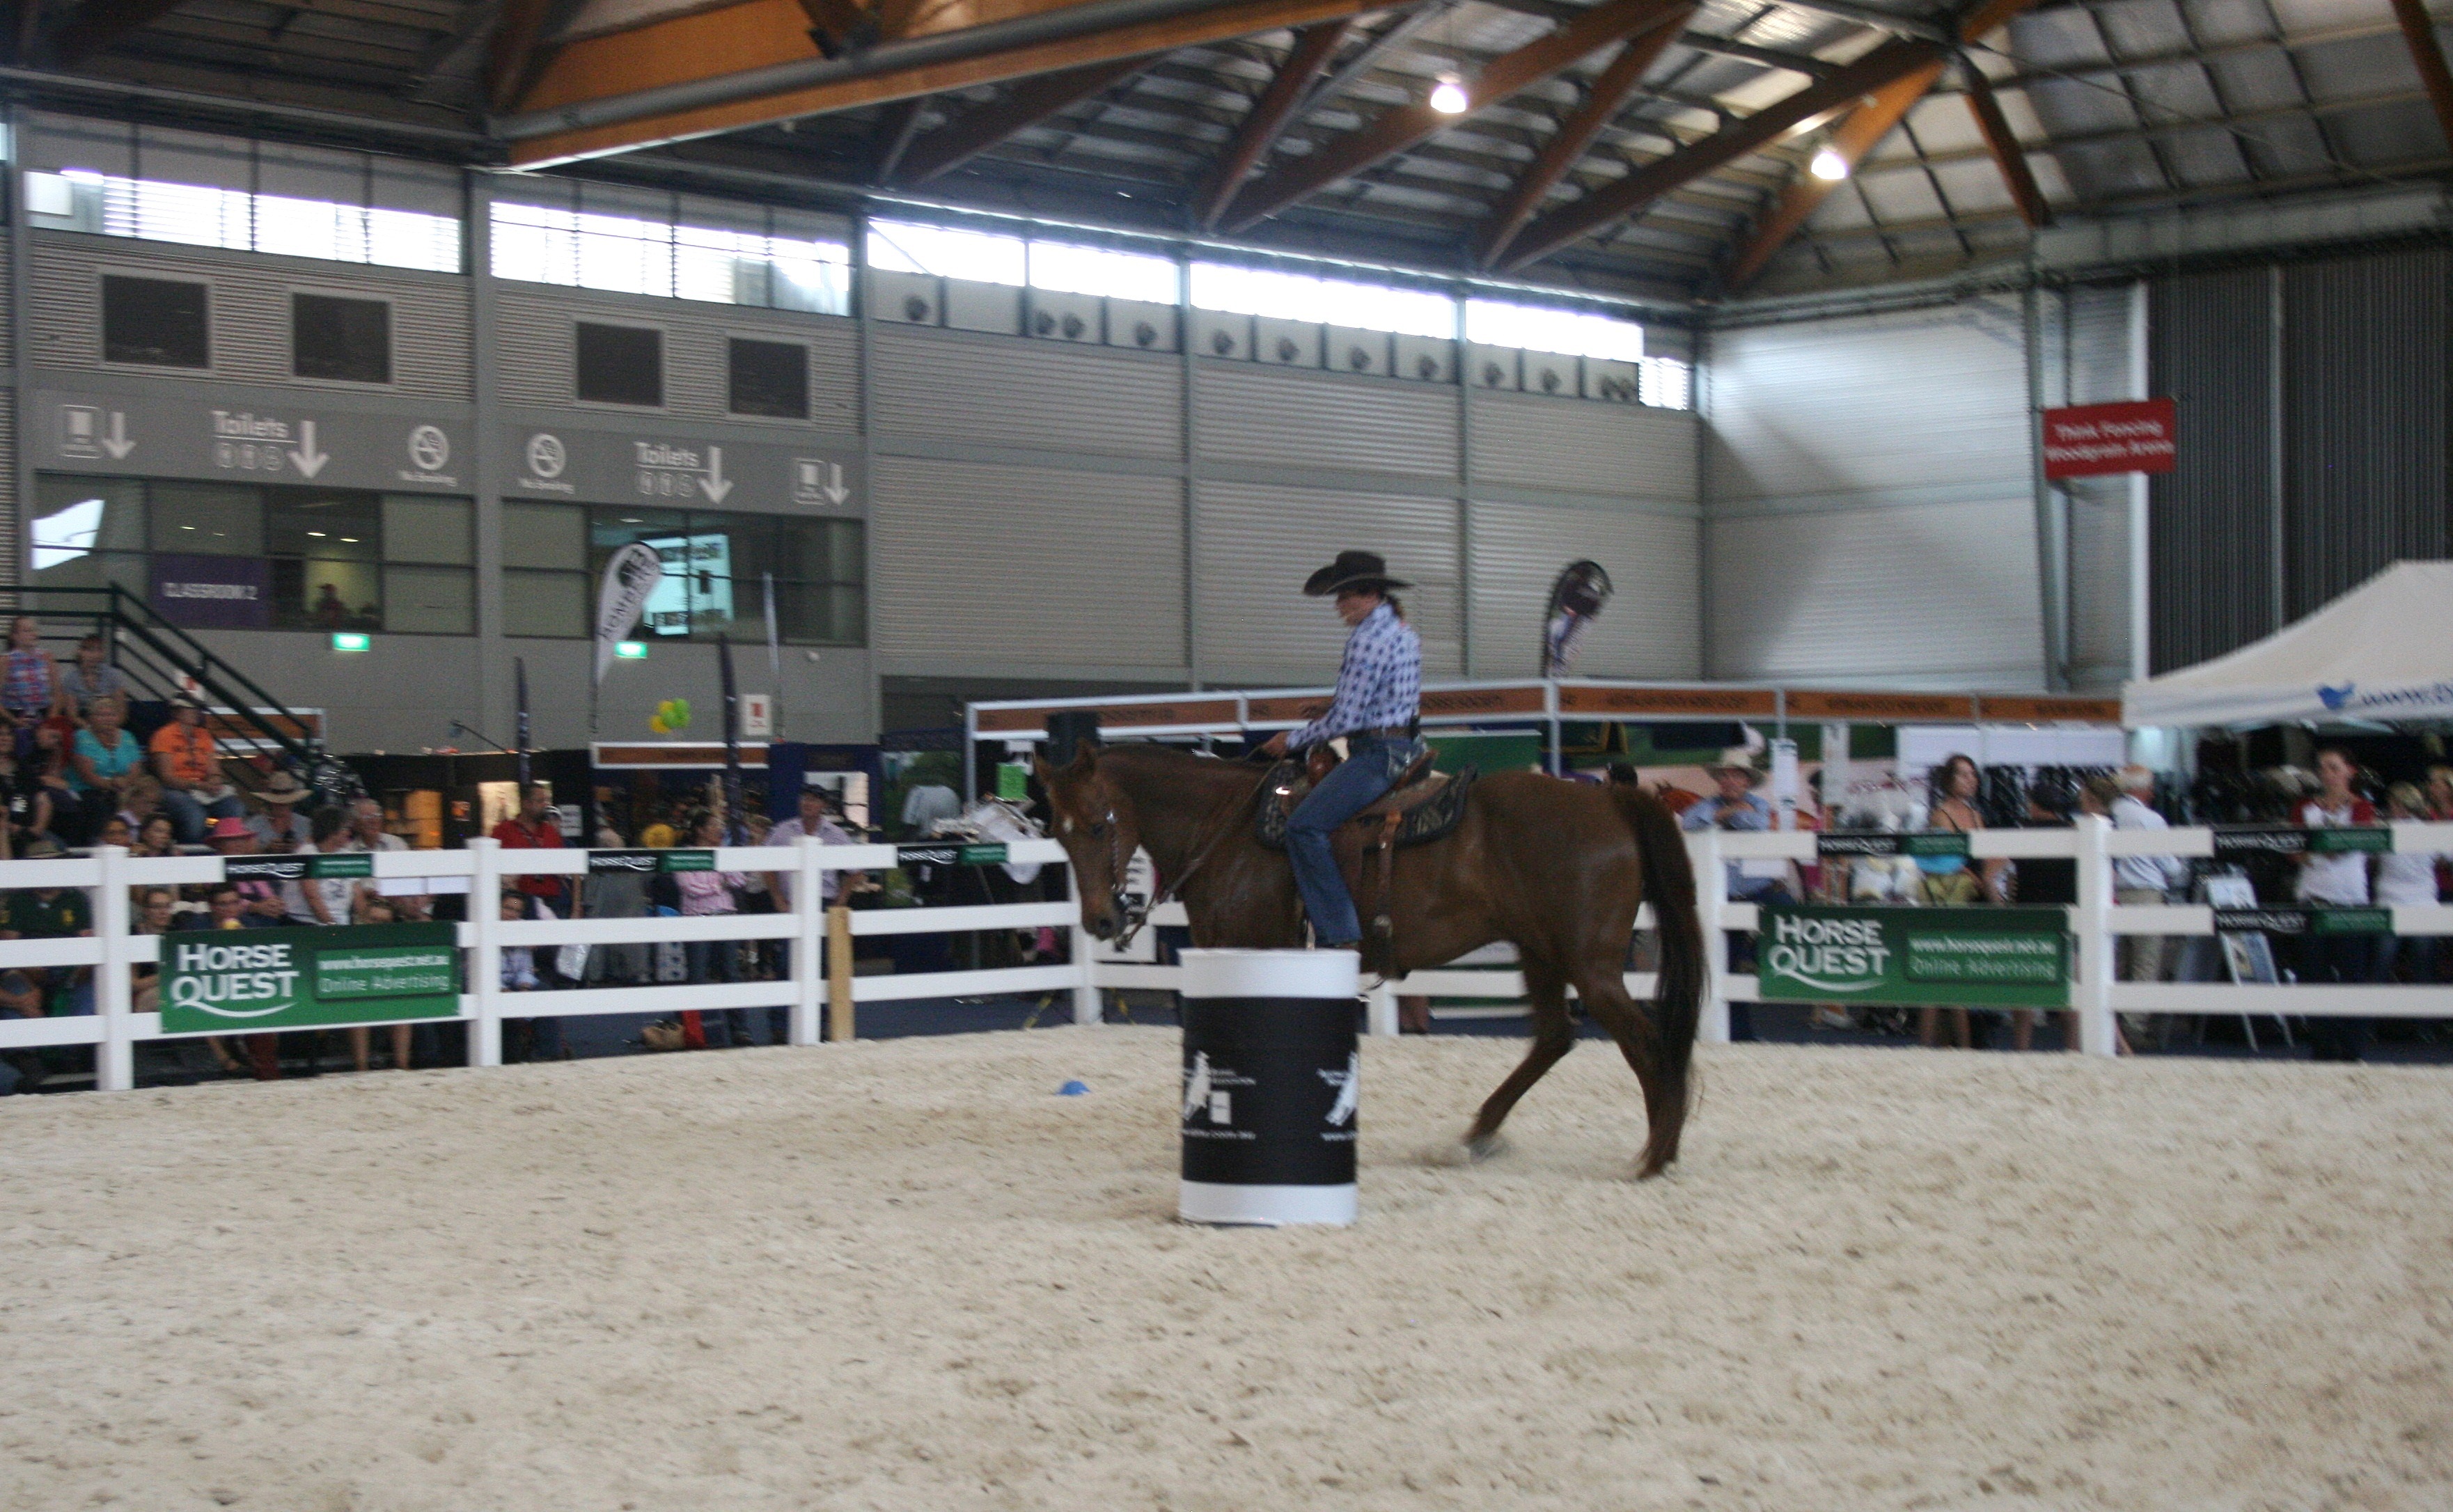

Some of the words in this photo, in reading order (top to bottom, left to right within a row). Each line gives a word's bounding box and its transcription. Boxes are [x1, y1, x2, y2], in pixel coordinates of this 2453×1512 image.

[211, 409, 289, 439] Toilets
[634, 441, 700, 468] Toilets
[1774, 914, 1883, 946] HORSE
[177, 943, 292, 972] HORSE
[1767, 944, 1891, 987] QUEST
[1910, 956, 1962, 976] Online
[1964, 956, 2057, 981] Advertising
[169, 970, 300, 1014] QUEST
[318, 977, 368, 993] Online
[371, 974, 450, 992] Advertising
